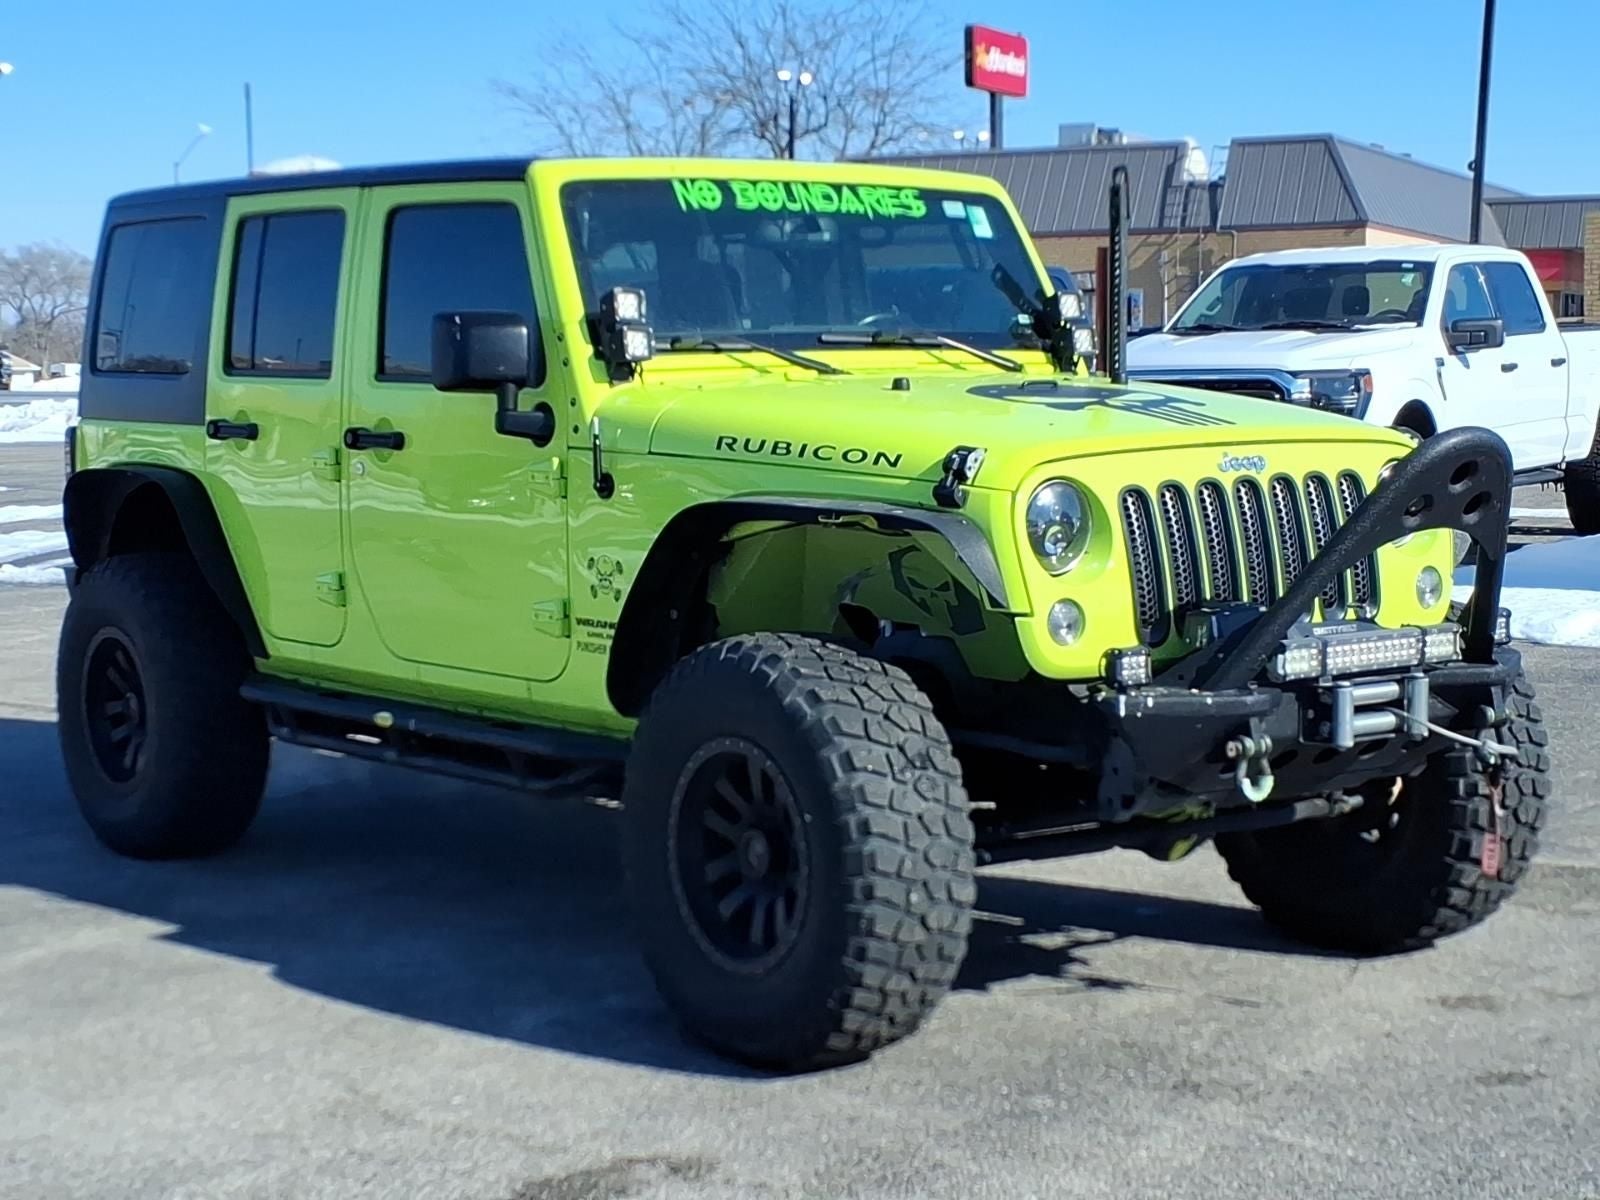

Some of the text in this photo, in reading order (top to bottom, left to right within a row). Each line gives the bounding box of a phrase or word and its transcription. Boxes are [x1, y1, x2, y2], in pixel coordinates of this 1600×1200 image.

[672, 178, 928, 219] NO BOUNDARIES
[715, 435, 903, 468] RUBICON
